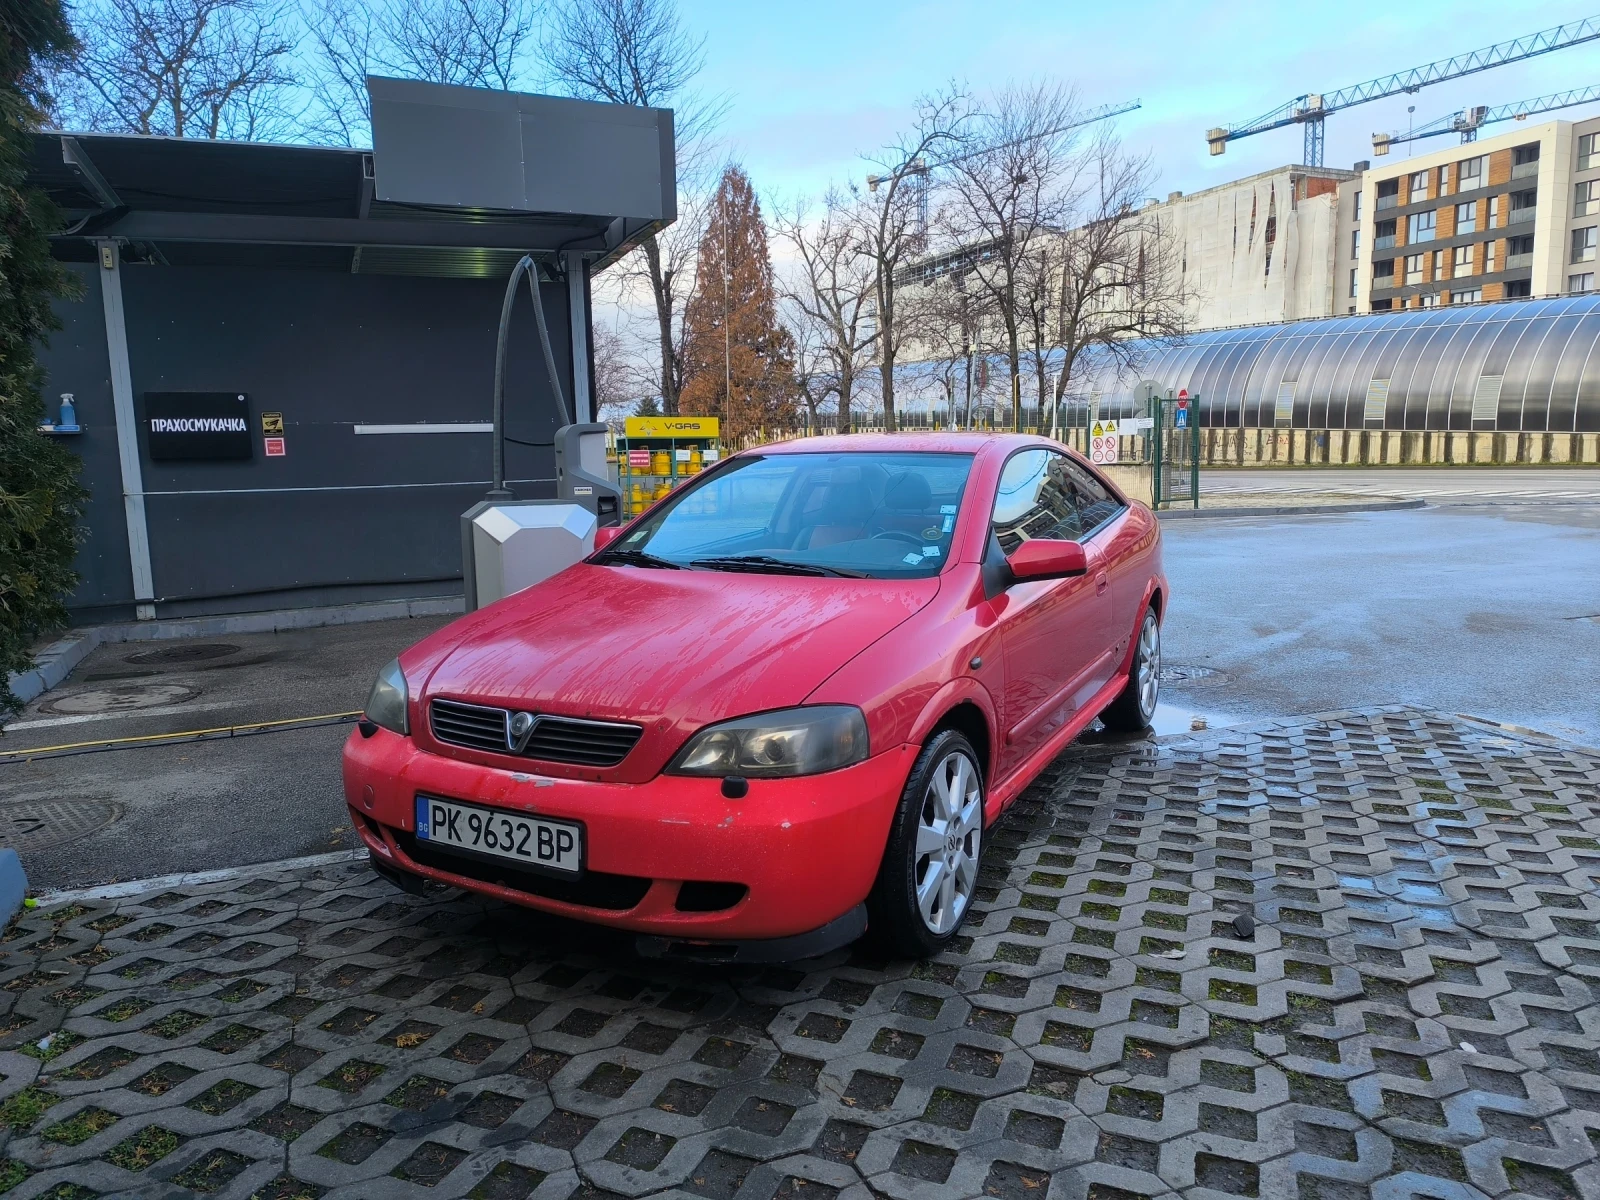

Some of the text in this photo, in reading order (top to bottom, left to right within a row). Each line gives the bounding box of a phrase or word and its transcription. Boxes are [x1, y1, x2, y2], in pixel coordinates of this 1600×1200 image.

[150, 418, 247, 432] ПРАХОСМУКАЧКА
[418, 821, 429, 833] BG
[432, 804, 574, 863] PK 9632 BP
